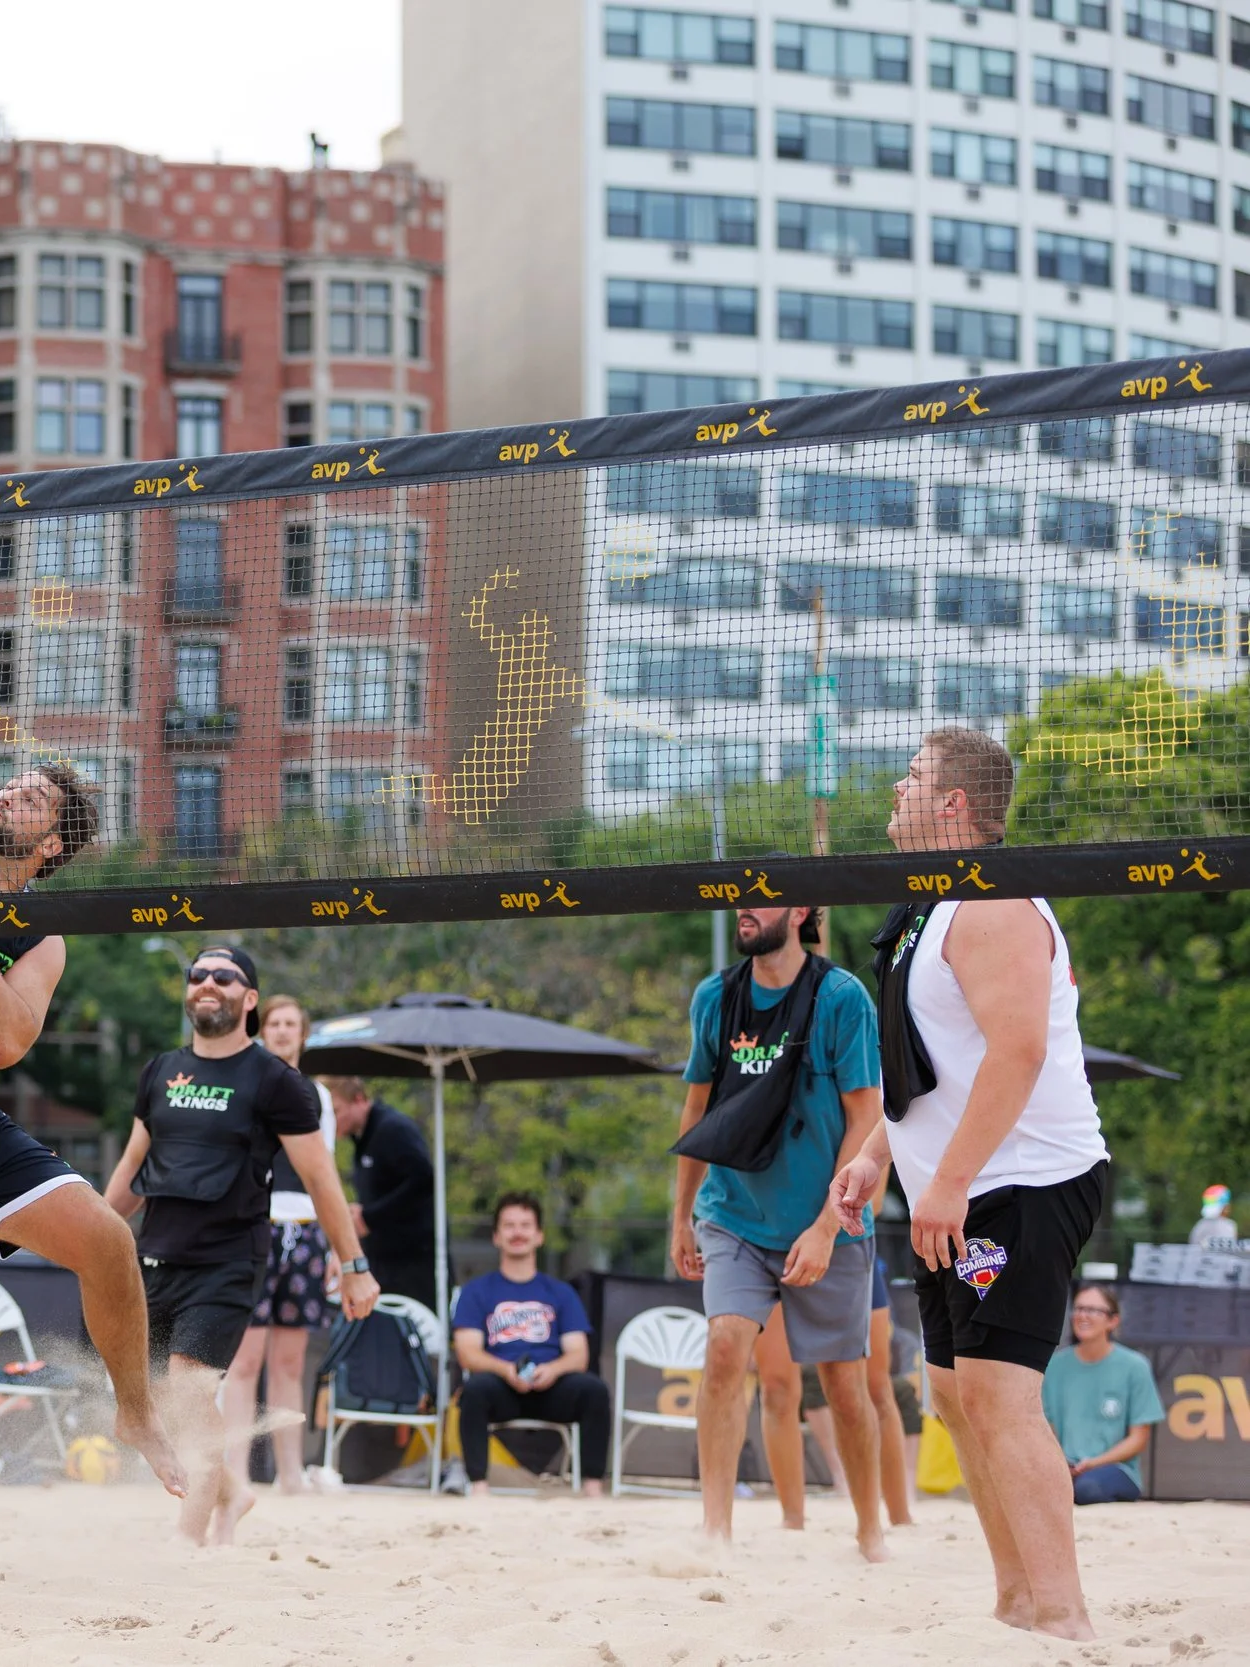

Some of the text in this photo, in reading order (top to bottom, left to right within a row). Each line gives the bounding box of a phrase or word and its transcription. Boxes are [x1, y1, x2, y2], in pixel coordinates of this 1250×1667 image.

[1121, 377, 1168, 400] avp
[903, 401, 947, 423] avp
[695, 422, 738, 443] avp
[499, 443, 538, 465] avp
[311, 462, 351, 481] avp
[133, 477, 171, 495] avp
[907, 874, 952, 896] avp
[1127, 863, 1175, 887] avp
[500, 892, 541, 912] avp
[698, 883, 741, 903] avp
[131, 907, 168, 926] avp
[311, 901, 350, 919] avp
[166, 1084, 235, 1100] DRAFT
[169, 1095, 229, 1112] KINGS
[957, 1252, 1007, 1278] COMBINE
